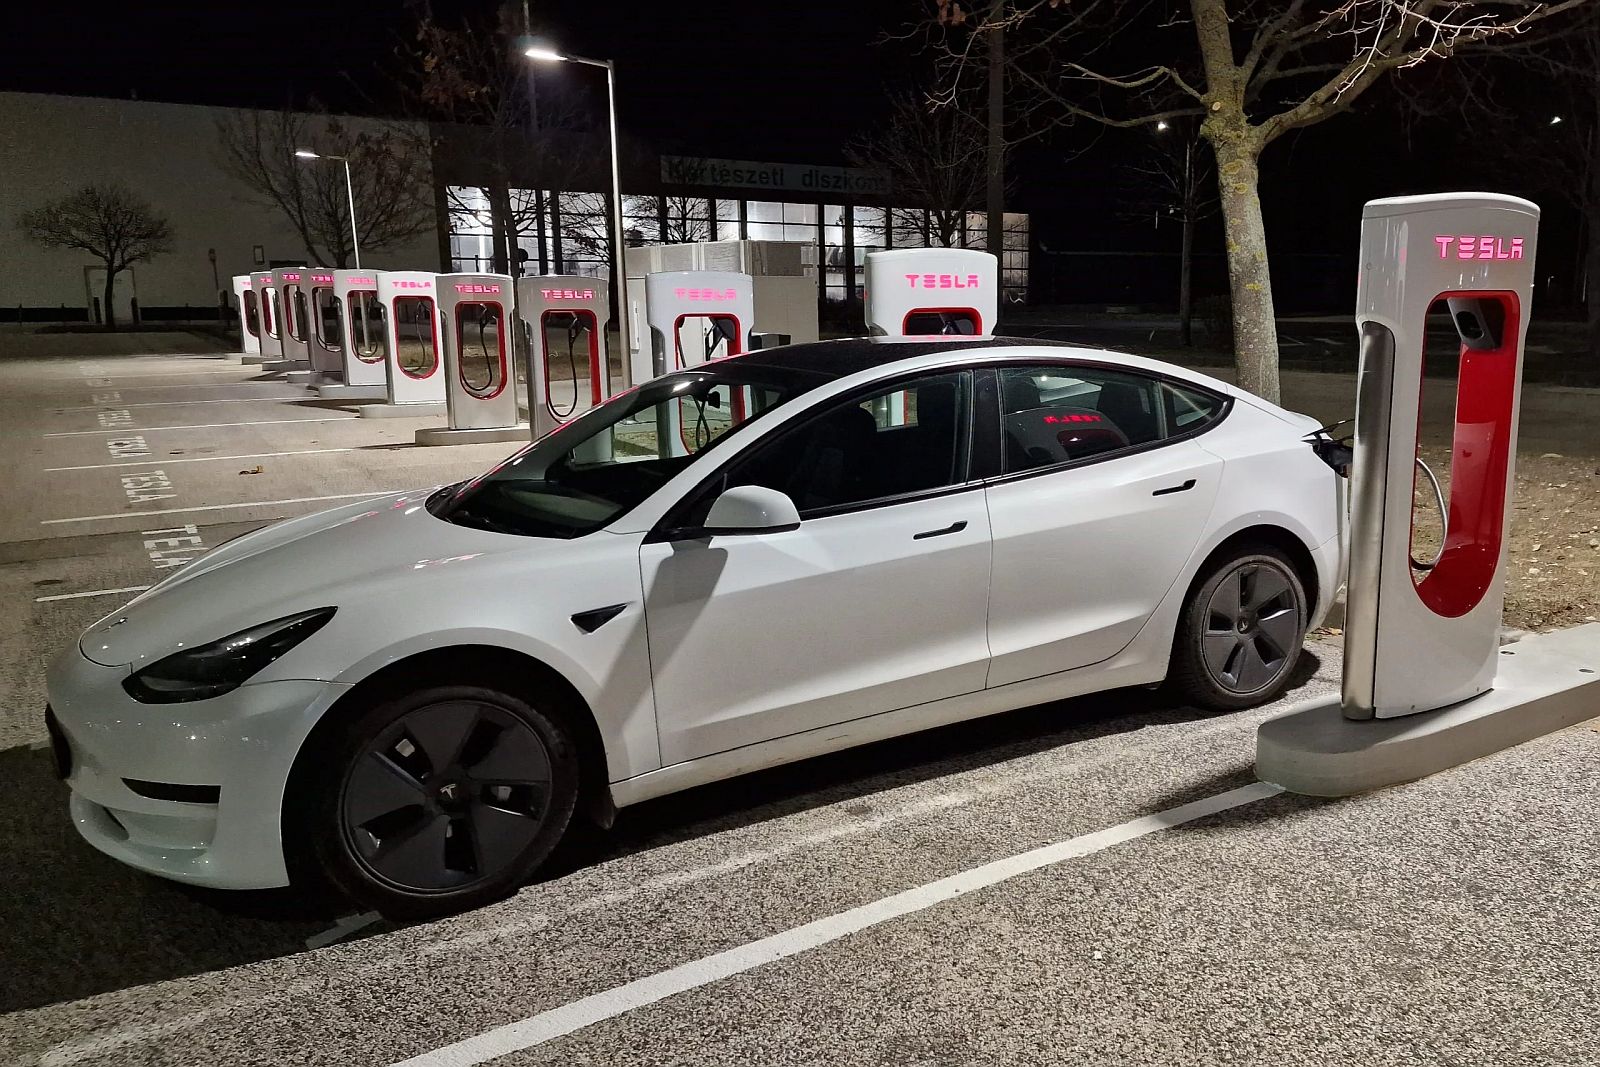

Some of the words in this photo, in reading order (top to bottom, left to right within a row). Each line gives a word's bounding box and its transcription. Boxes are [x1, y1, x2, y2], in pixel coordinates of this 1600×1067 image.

[1434, 236, 1524, 260] TESLA
[347, 277, 375, 286] TESL
[392, 280, 432, 289] TESLA
[904, 273, 979, 289] TESLA
[454, 284, 501, 294] TESLA
[541, 289, 594, 300] TESLA
[674, 287, 737, 301] TESLA
[119, 469, 177, 503] TESLA
